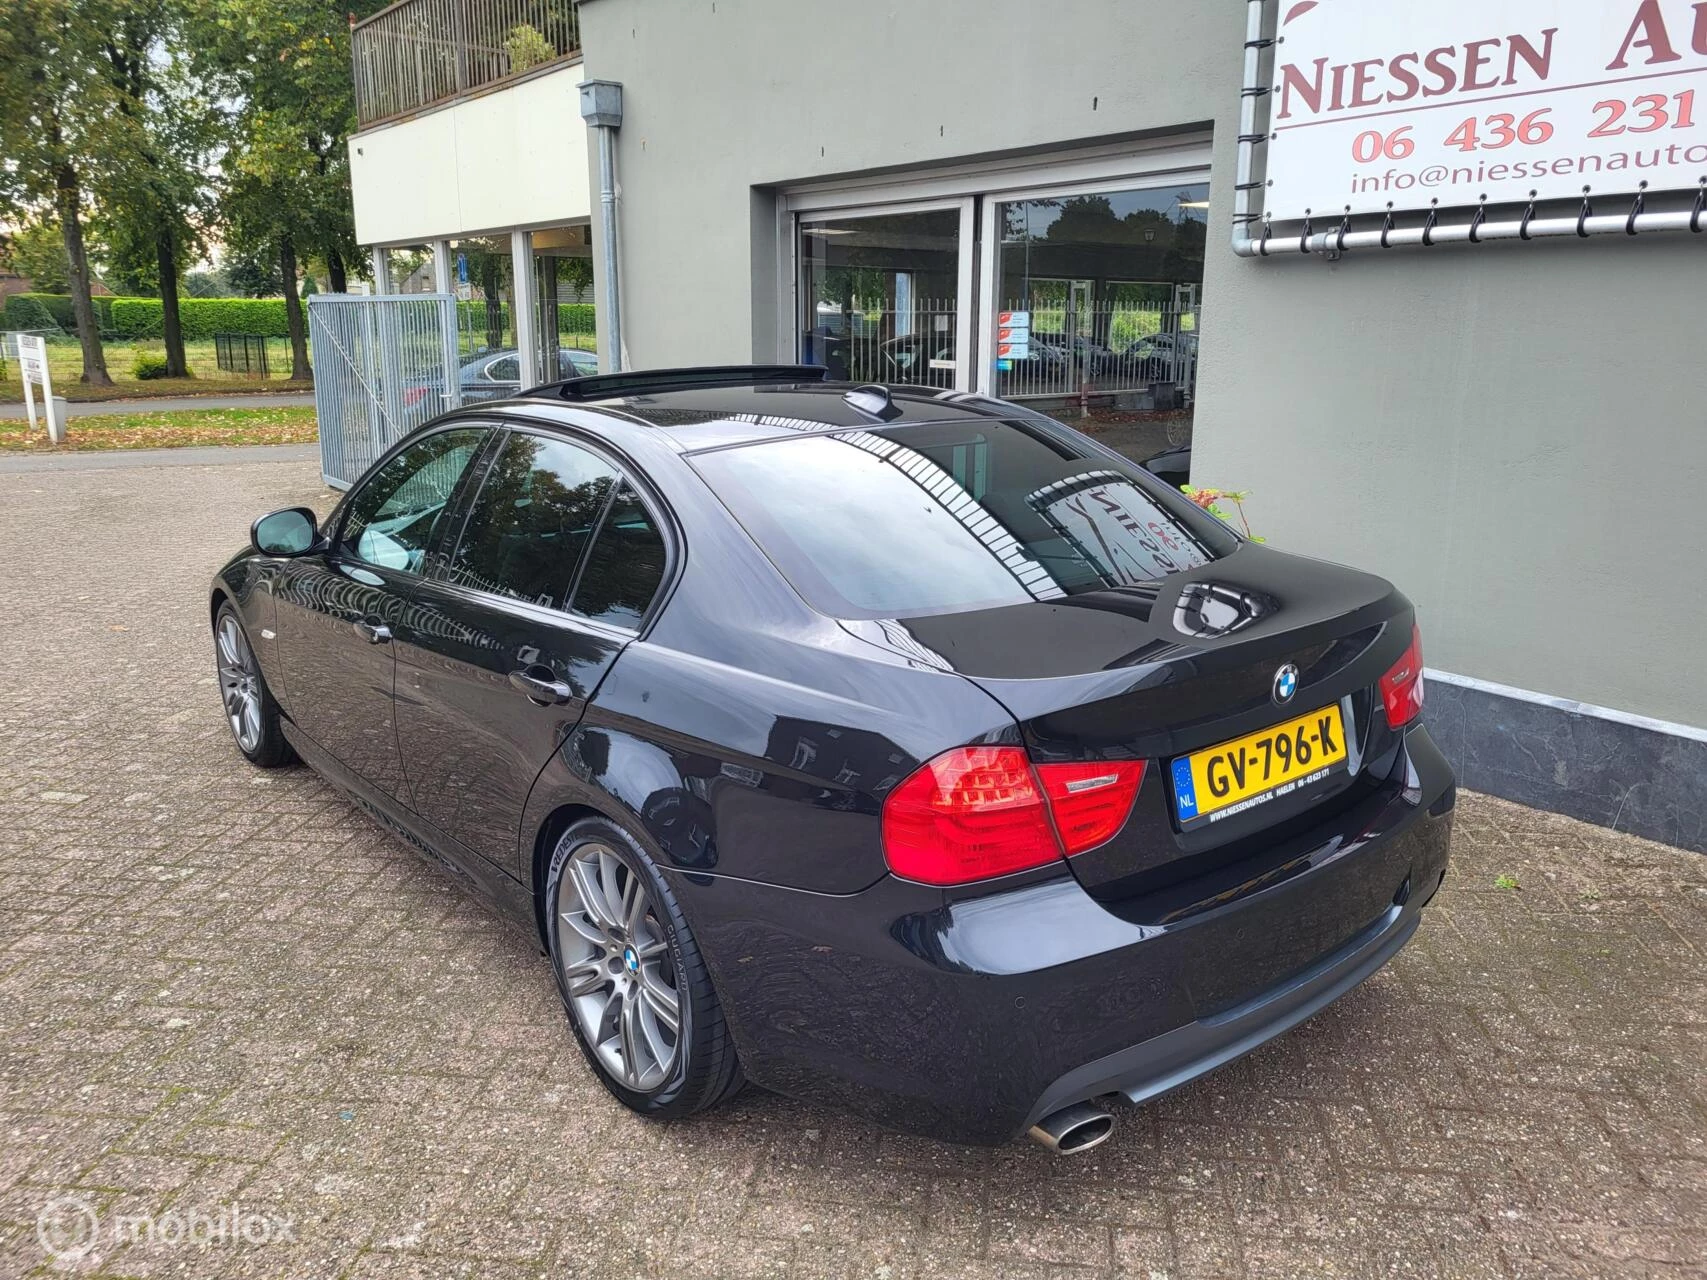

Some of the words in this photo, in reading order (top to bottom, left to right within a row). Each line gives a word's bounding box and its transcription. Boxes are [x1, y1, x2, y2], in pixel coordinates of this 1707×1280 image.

[1276, 28, 1558, 119] NIESSEN
[1351, 125, 1415, 163] 06
[1443, 107, 1554, 152] 436
[1587, 89, 1696, 138] 231
[1351, 144, 1707, 194] info@niessenauto
[1207, 716, 1337, 798] GV-796-K
[1179, 794, 1194, 809] NL
[1209, 791, 1273, 823] WWW.NIESSENAUTOS.NL
